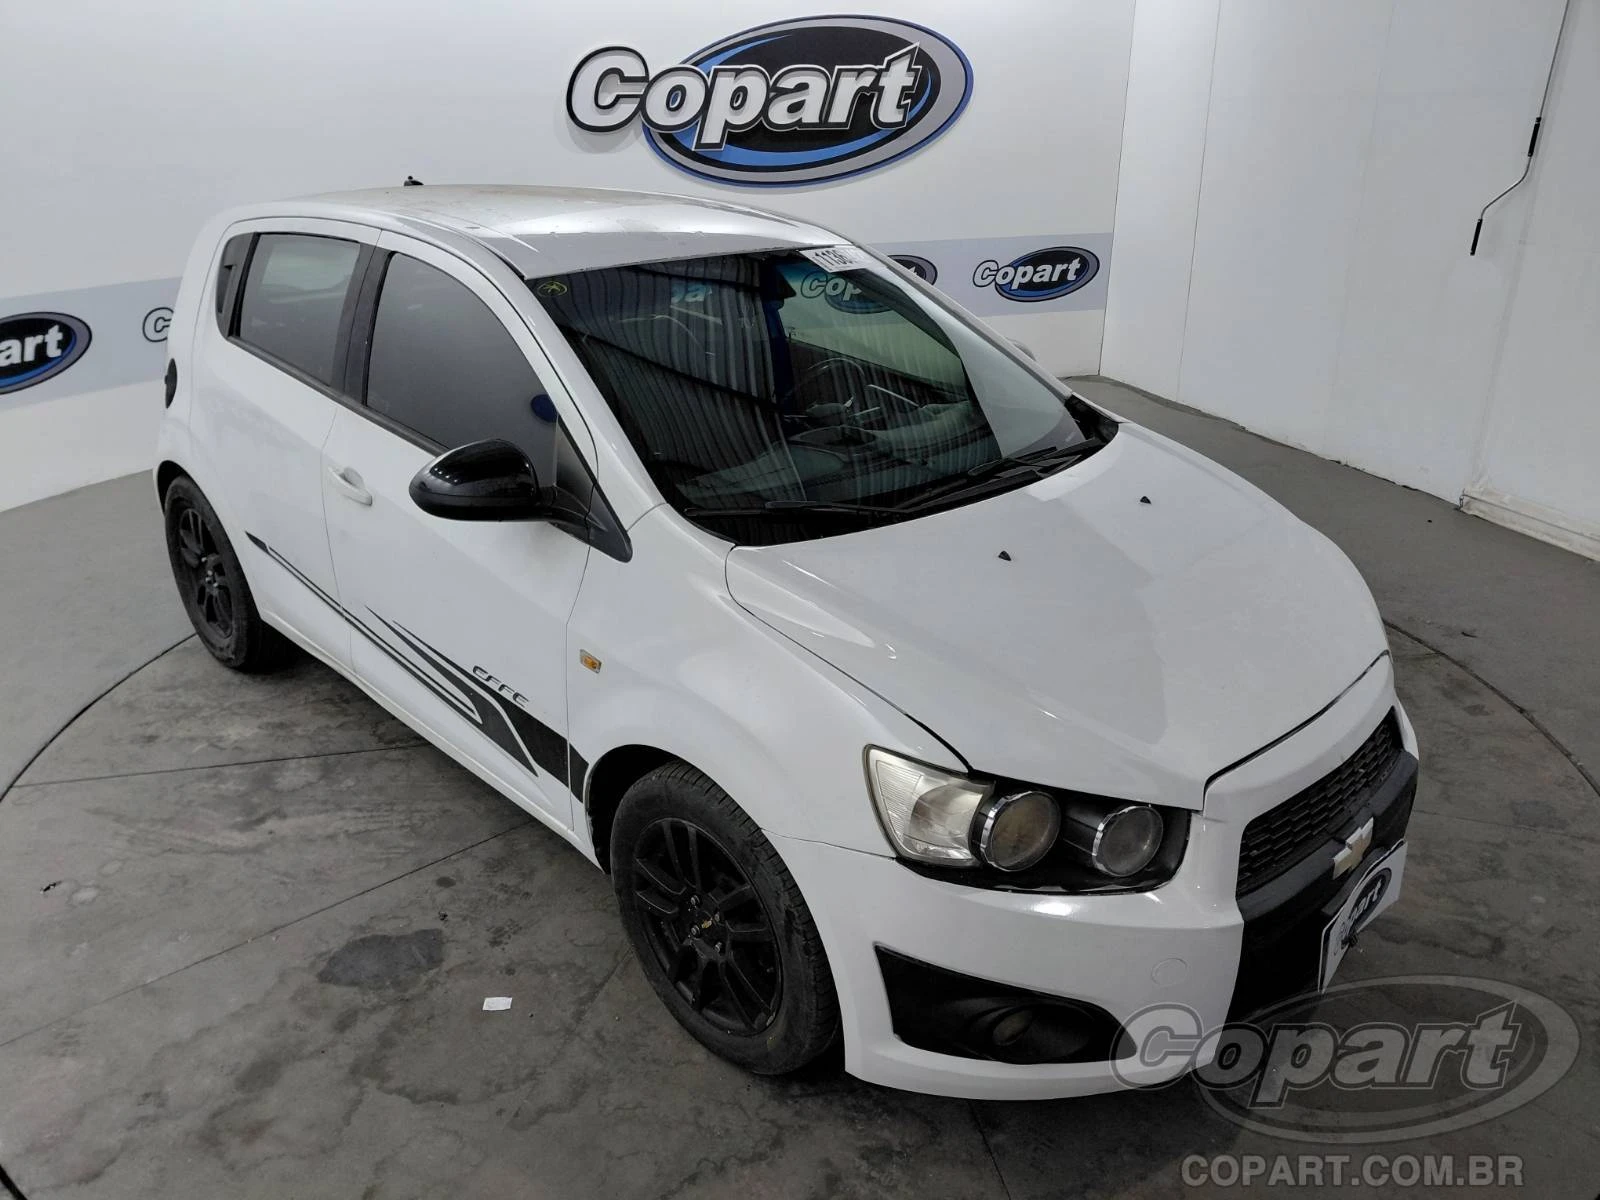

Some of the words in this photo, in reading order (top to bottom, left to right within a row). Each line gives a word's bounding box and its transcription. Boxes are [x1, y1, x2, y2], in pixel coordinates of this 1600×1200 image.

[566, 43, 921, 151] Copart
[801, 271, 862, 301] Cop
[973, 258, 1081, 290] Copart
[0, 324, 63, 368] art
